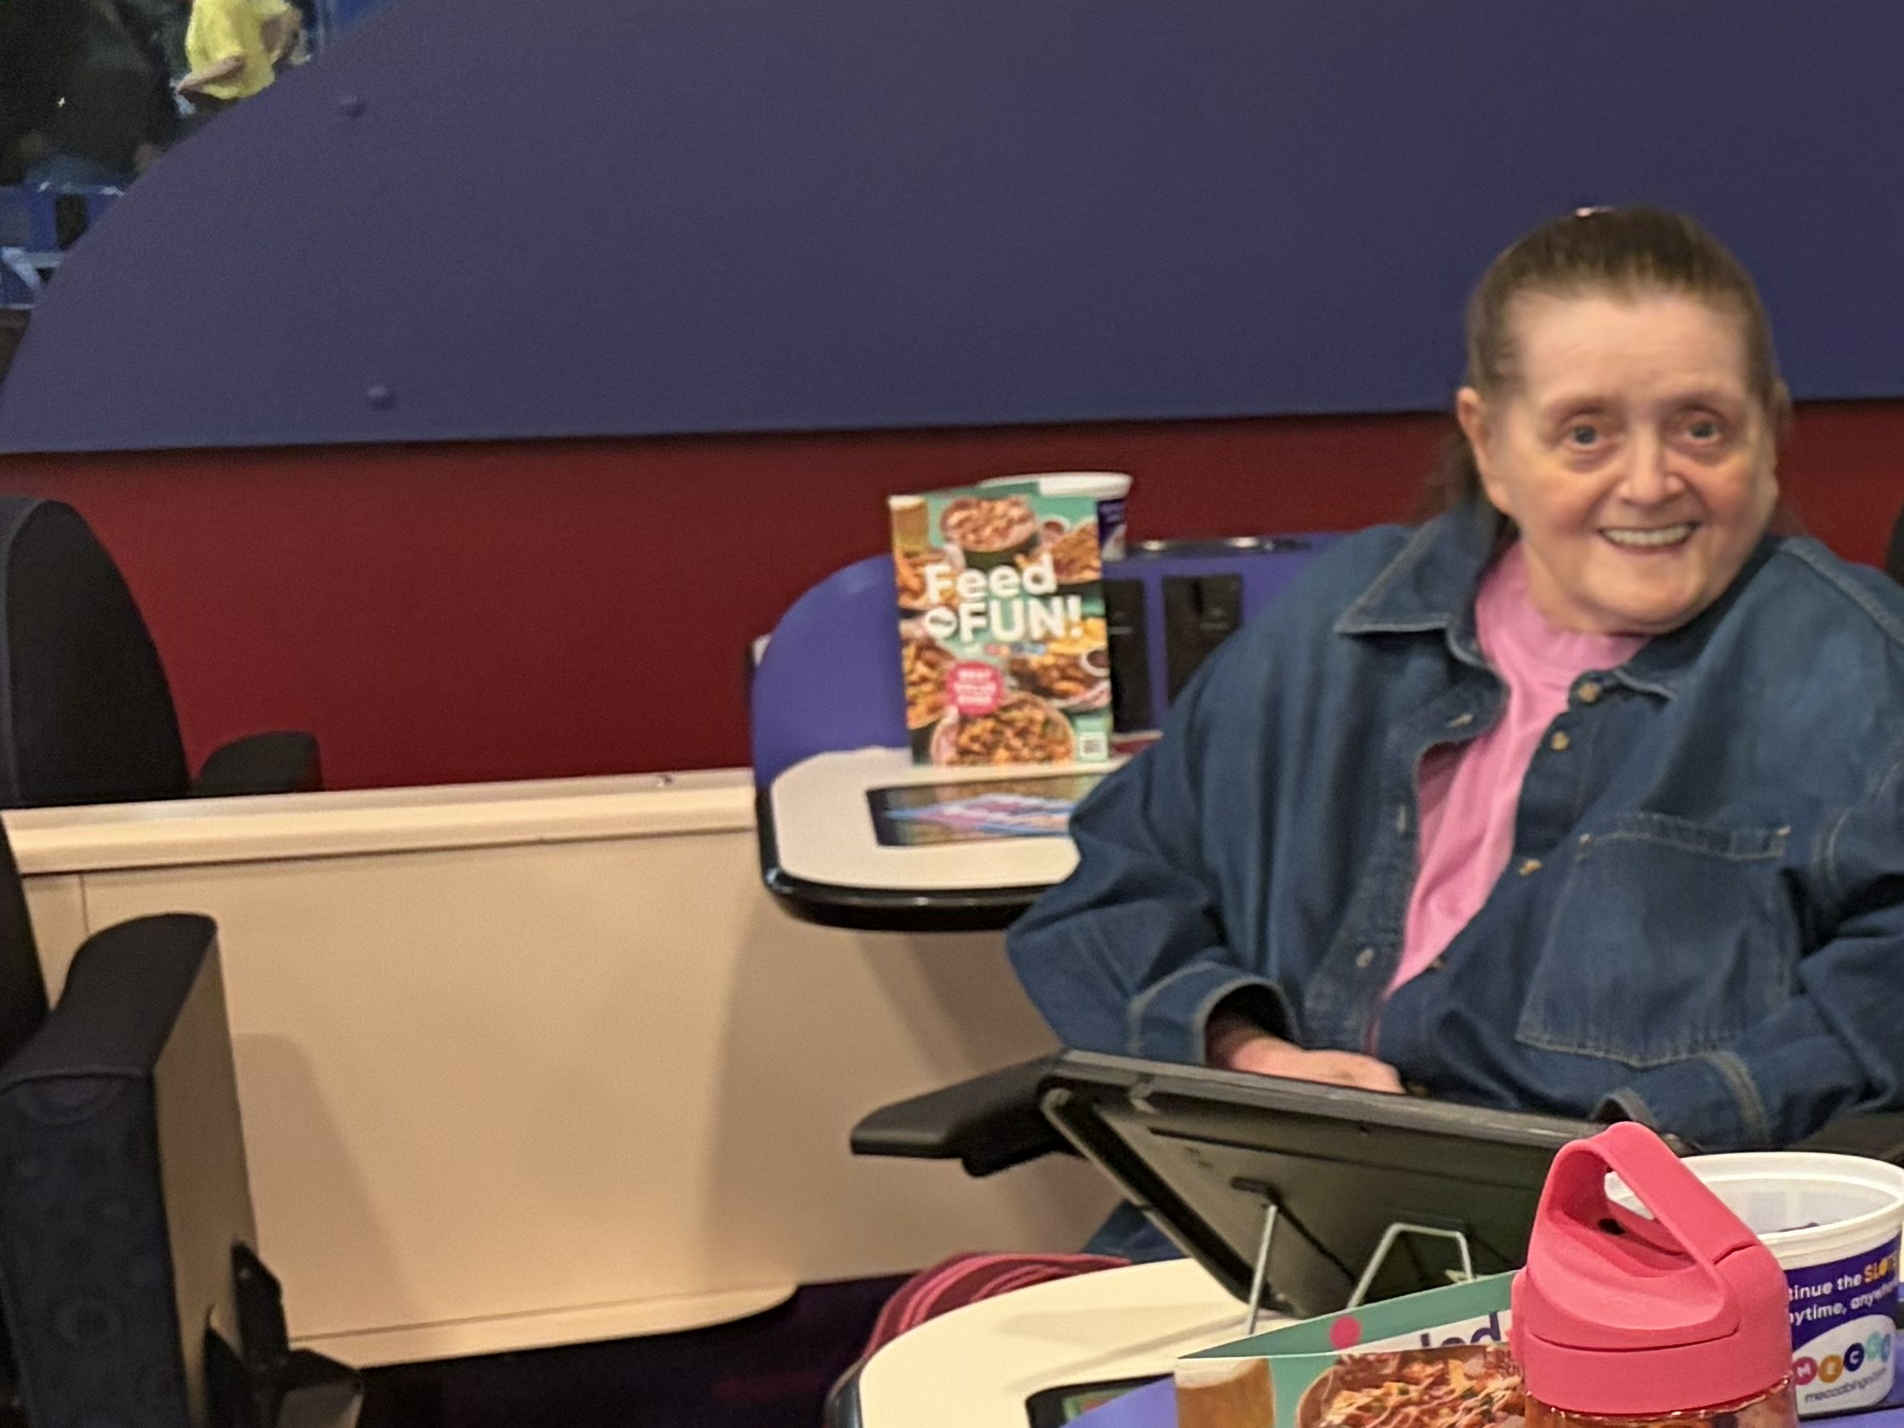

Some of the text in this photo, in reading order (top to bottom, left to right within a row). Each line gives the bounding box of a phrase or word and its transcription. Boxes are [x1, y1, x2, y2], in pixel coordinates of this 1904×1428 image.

[925, 553, 1058, 603] Feed
[958, 595, 1083, 642] FUN!
[1788, 1281, 1834, 1302] tinue
[1837, 1273, 1862, 1291] the
